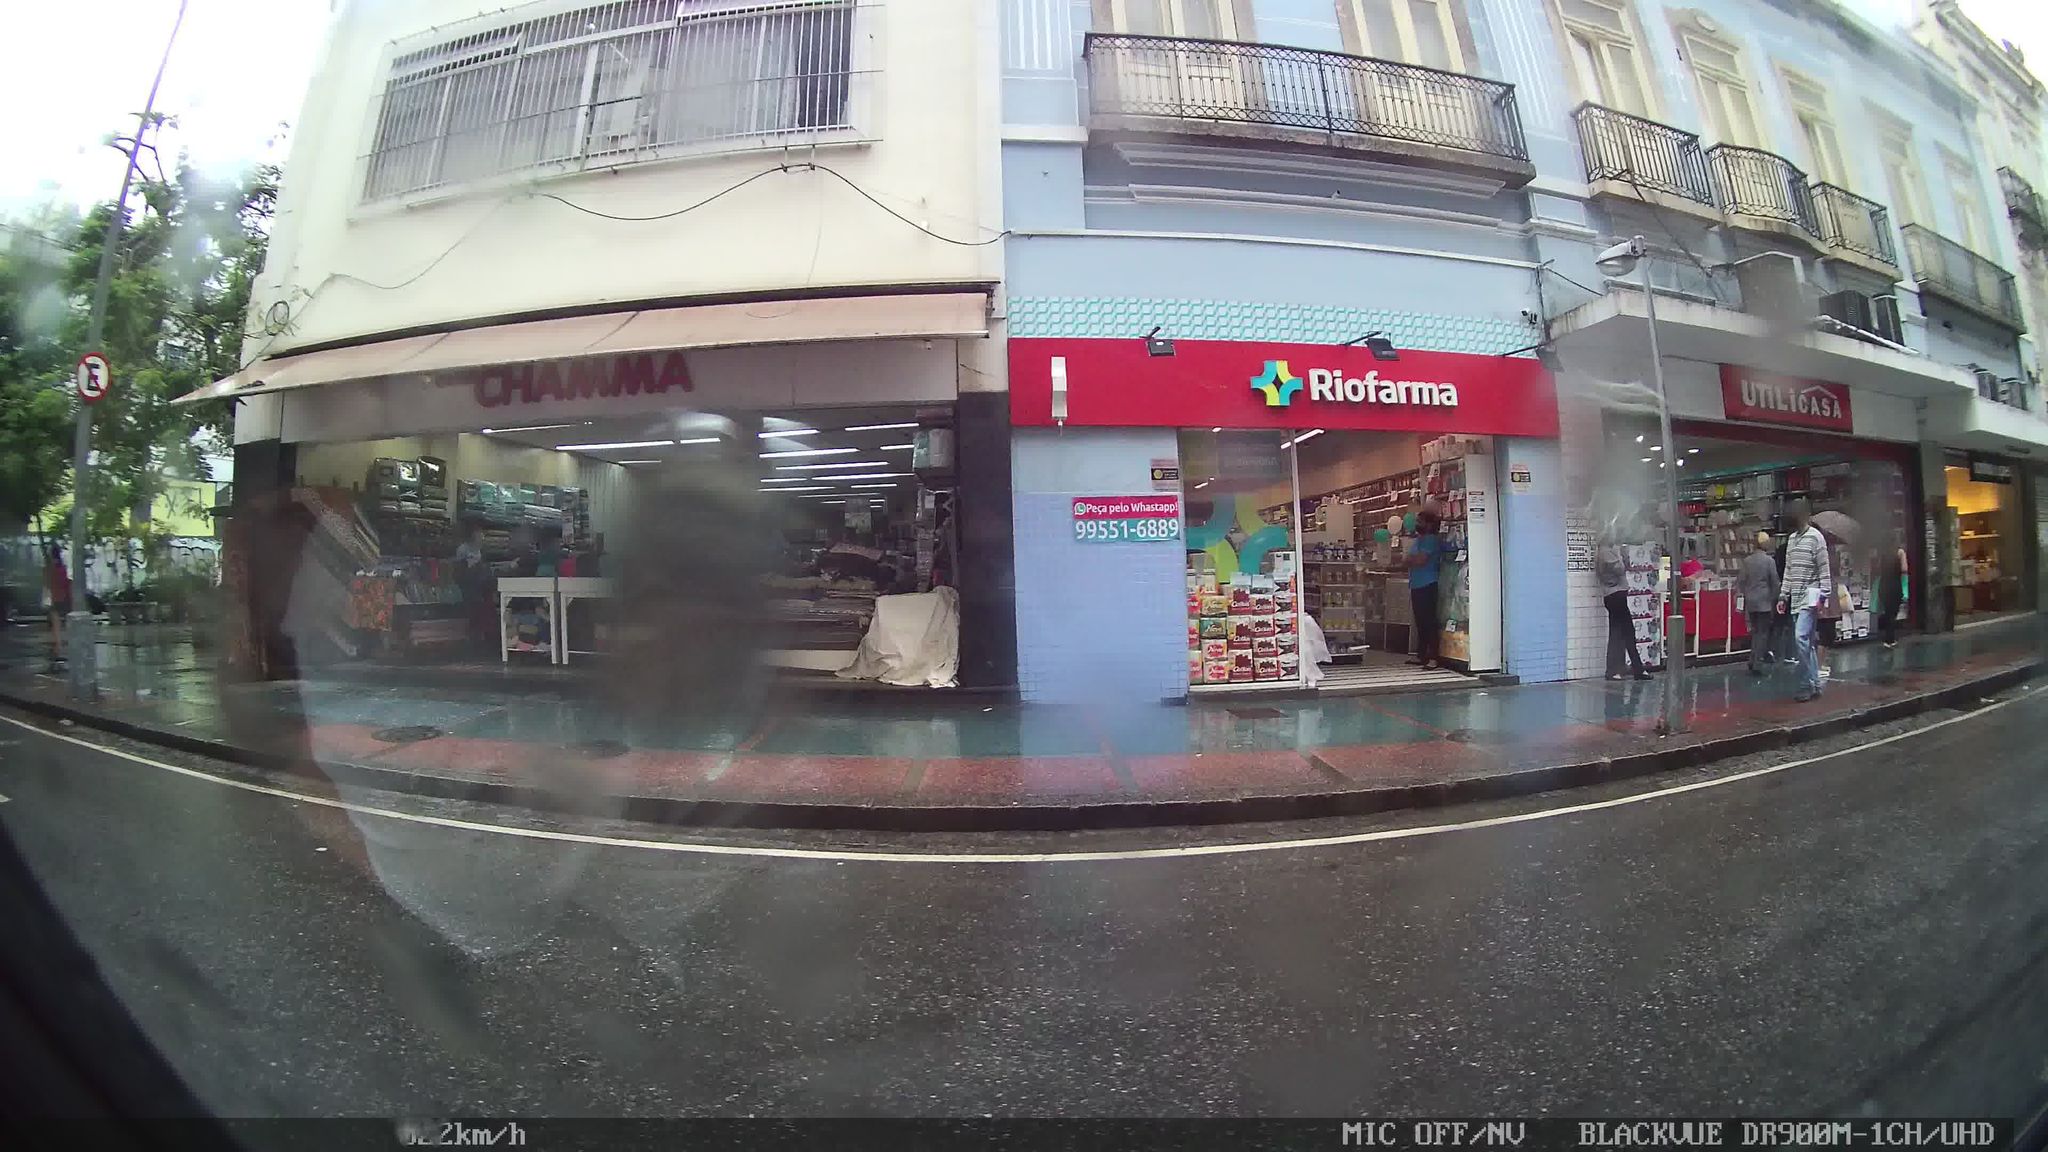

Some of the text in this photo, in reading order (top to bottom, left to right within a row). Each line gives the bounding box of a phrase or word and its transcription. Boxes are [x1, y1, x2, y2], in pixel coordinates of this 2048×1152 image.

[87, 363, 100, 391] E
[1308, 368, 1458, 406] Riofarma
[1086, 503, 1107, 515] Peça
[1109, 502, 1130, 514] pelo
[1075, 519, 1180, 539] 99551-6889
